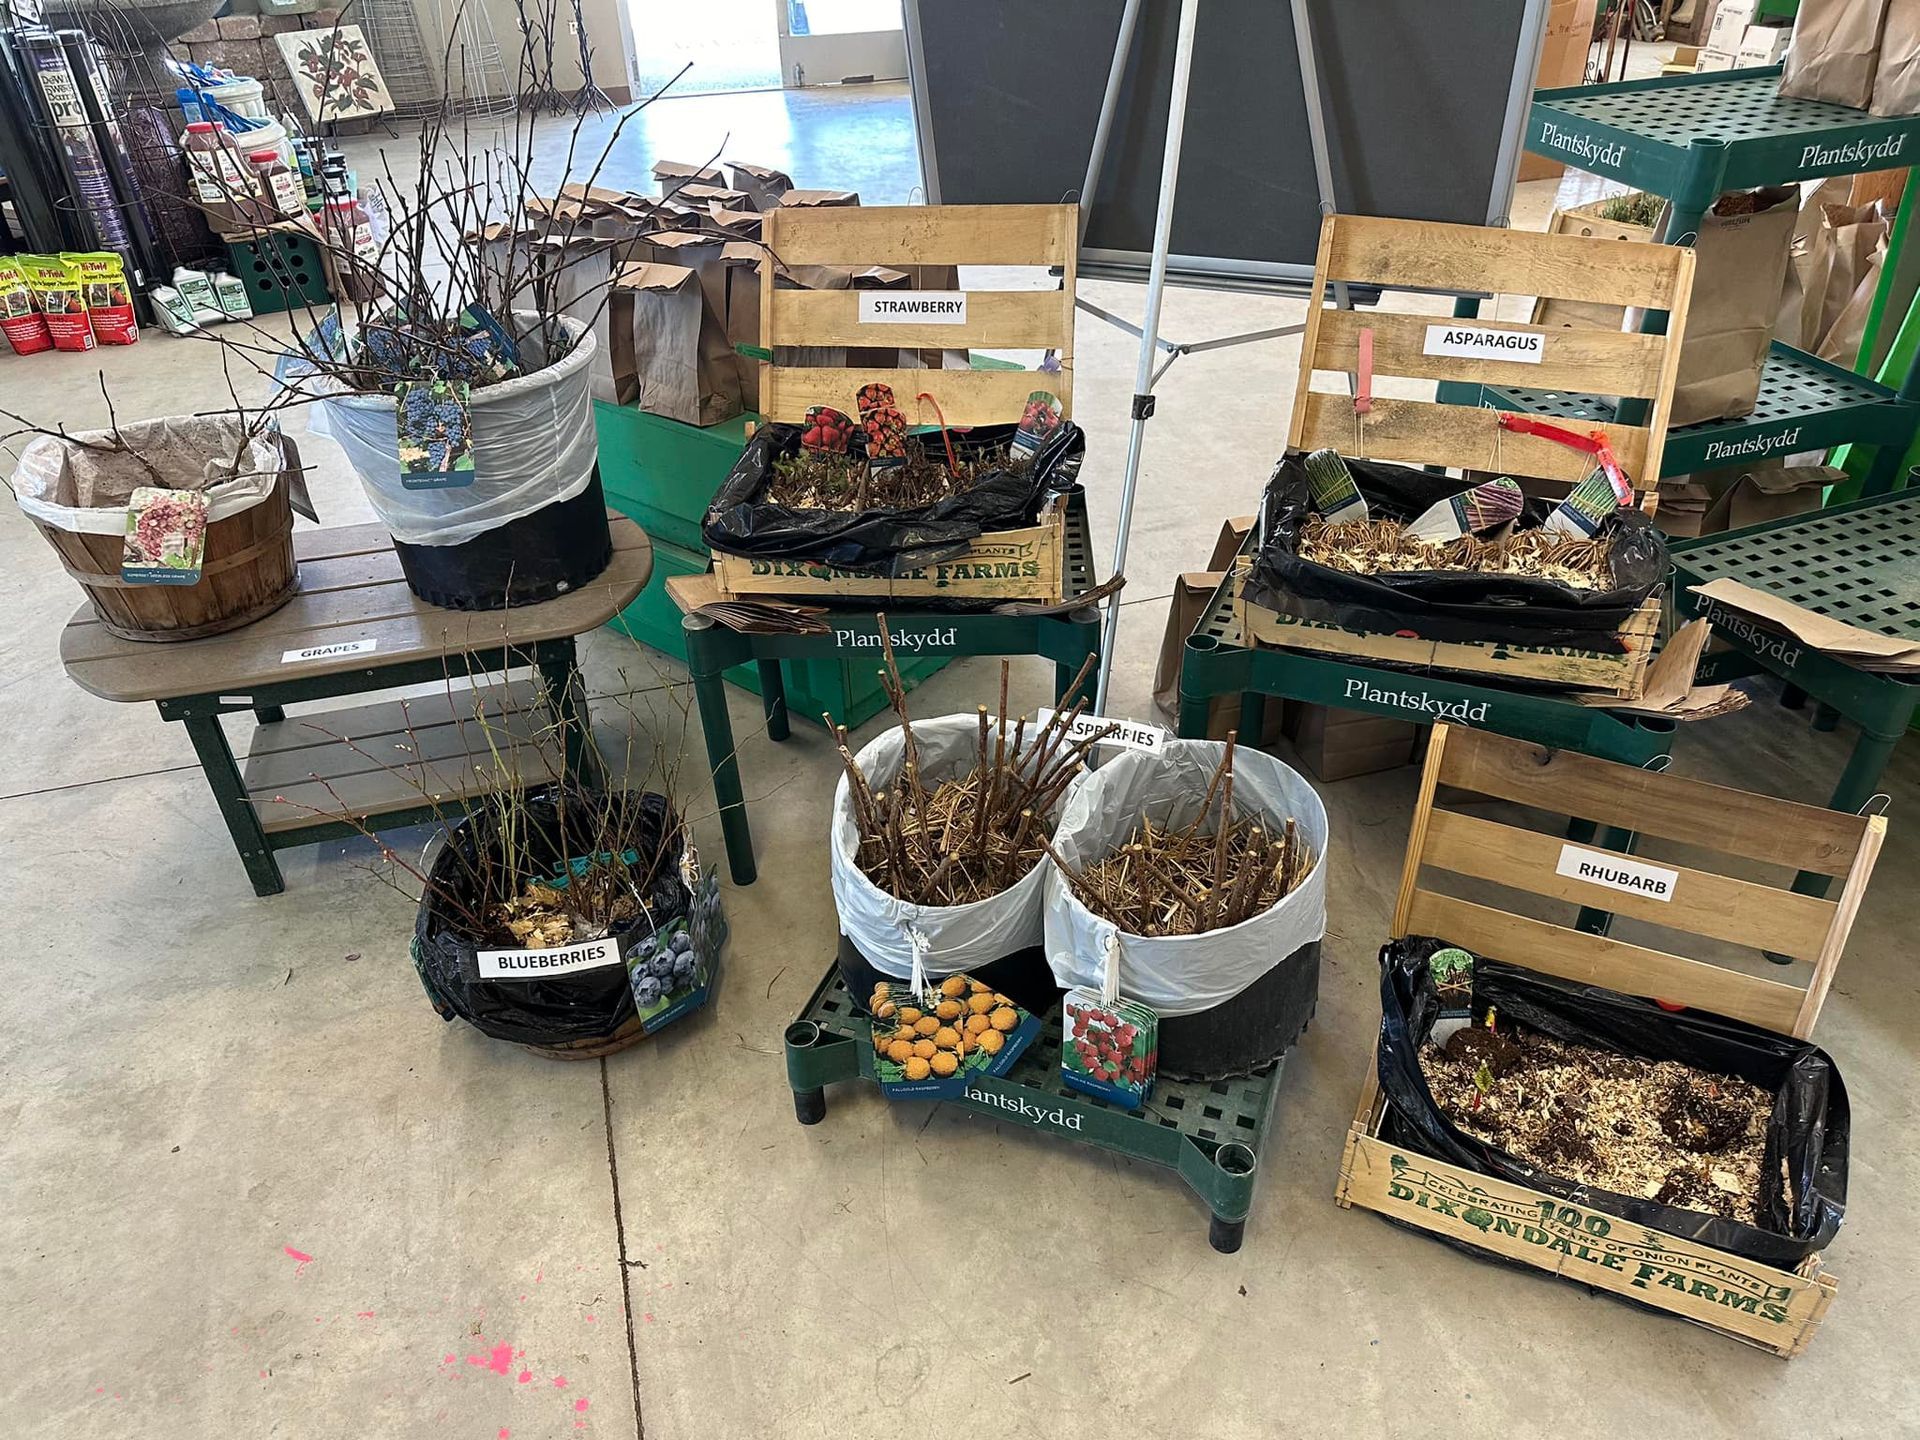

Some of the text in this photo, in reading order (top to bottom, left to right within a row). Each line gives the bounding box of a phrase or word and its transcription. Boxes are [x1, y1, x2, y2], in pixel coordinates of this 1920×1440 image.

[1540, 122, 1623, 168] Plantskydd
[1798, 134, 1904, 169] Plantskydd
[874, 301, 963, 313] STRAWBERRY
[1443, 331, 1538, 351] ASPARAGUS
[1704, 427, 1801, 461] Plantskydd
[936, 561, 1040, 586] FARMS
[835, 628, 957, 652] Planskydd
[1693, 594, 1801, 669] Plantskydd
[301, 643, 360, 658] GRAPES
[1344, 678, 1488, 723] Plantskydd
[1055, 720, 1154, 746] RSPBRRIES
[1579, 863, 1667, 894] RHUBARB
[498, 946, 606, 969] BLUEBERRIES
[963, 1085, 1083, 1131] lantskydd
[1428, 1179, 1611, 1238] CELEBRATING 100
[1550, 1222, 1761, 1290] YEARS OF ONION PLANTS
[1631, 1262, 1789, 1324] FARMS
